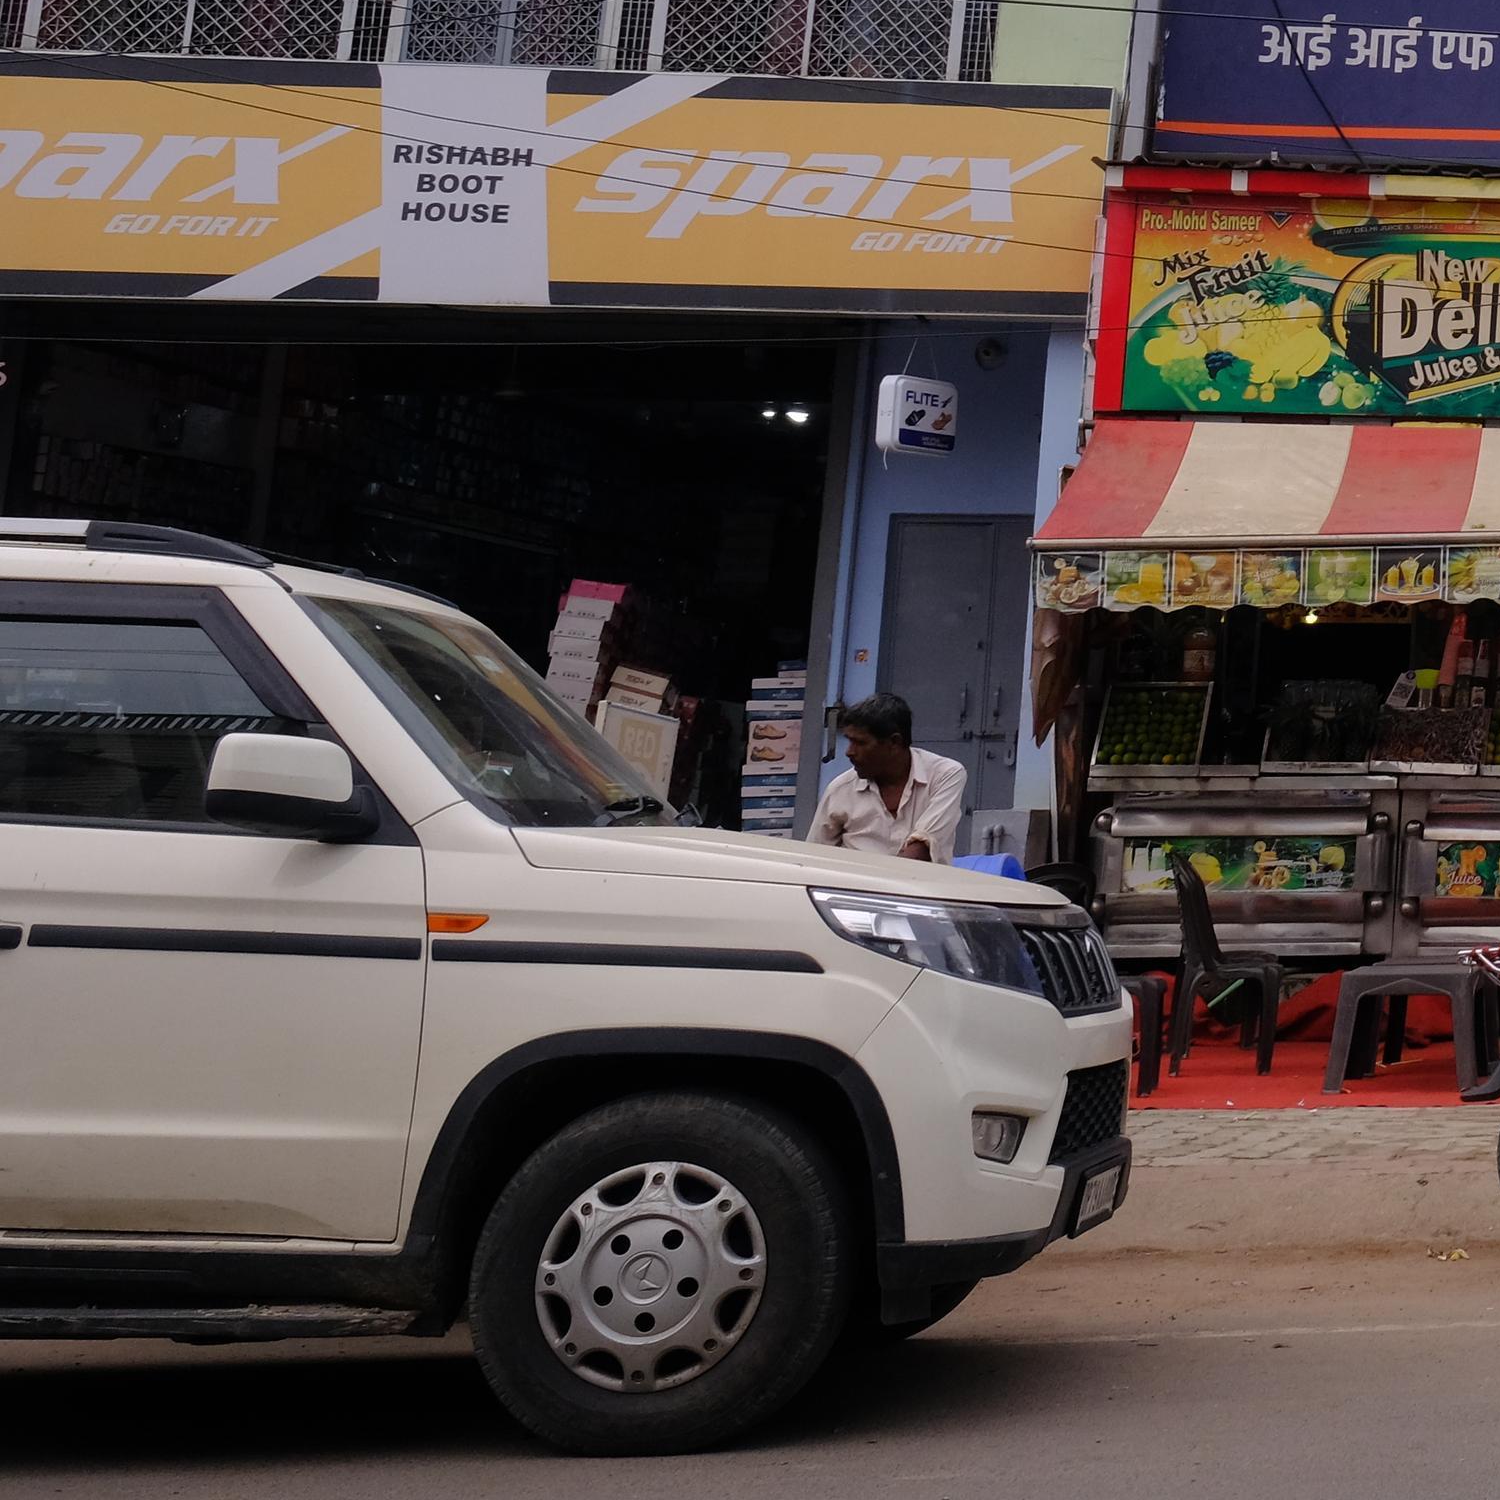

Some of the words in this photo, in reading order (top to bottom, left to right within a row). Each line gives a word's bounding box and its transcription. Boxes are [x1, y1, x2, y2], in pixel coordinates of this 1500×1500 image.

[1258, 13, 1337, 71] आई
[1345, 16, 1422, 73] आई
[392, 144, 534, 168] RISHABH
[416, 173, 504, 196] BOOT
[573, 145, 1085, 240] sparx
[103, 213, 158, 235] GO
[159, 214, 236, 236] FOR
[236, 216, 280, 238] IT
[400, 202, 510, 225] HOUSE
[1211, 211, 1262, 232] Sameer
[850, 231, 902, 252] GO
[903, 232, 974, 254] FOR
[974, 234, 1014, 255] IT
[1153, 248, 1210, 287] Mix
[1178, 249, 1272, 307] Fruit
[1419, 248, 1490, 284] New
[1408, 352, 1479, 389] Juice
[905, 390, 939, 408] FLITE
[1446, 871, 1482, 887] Juice
